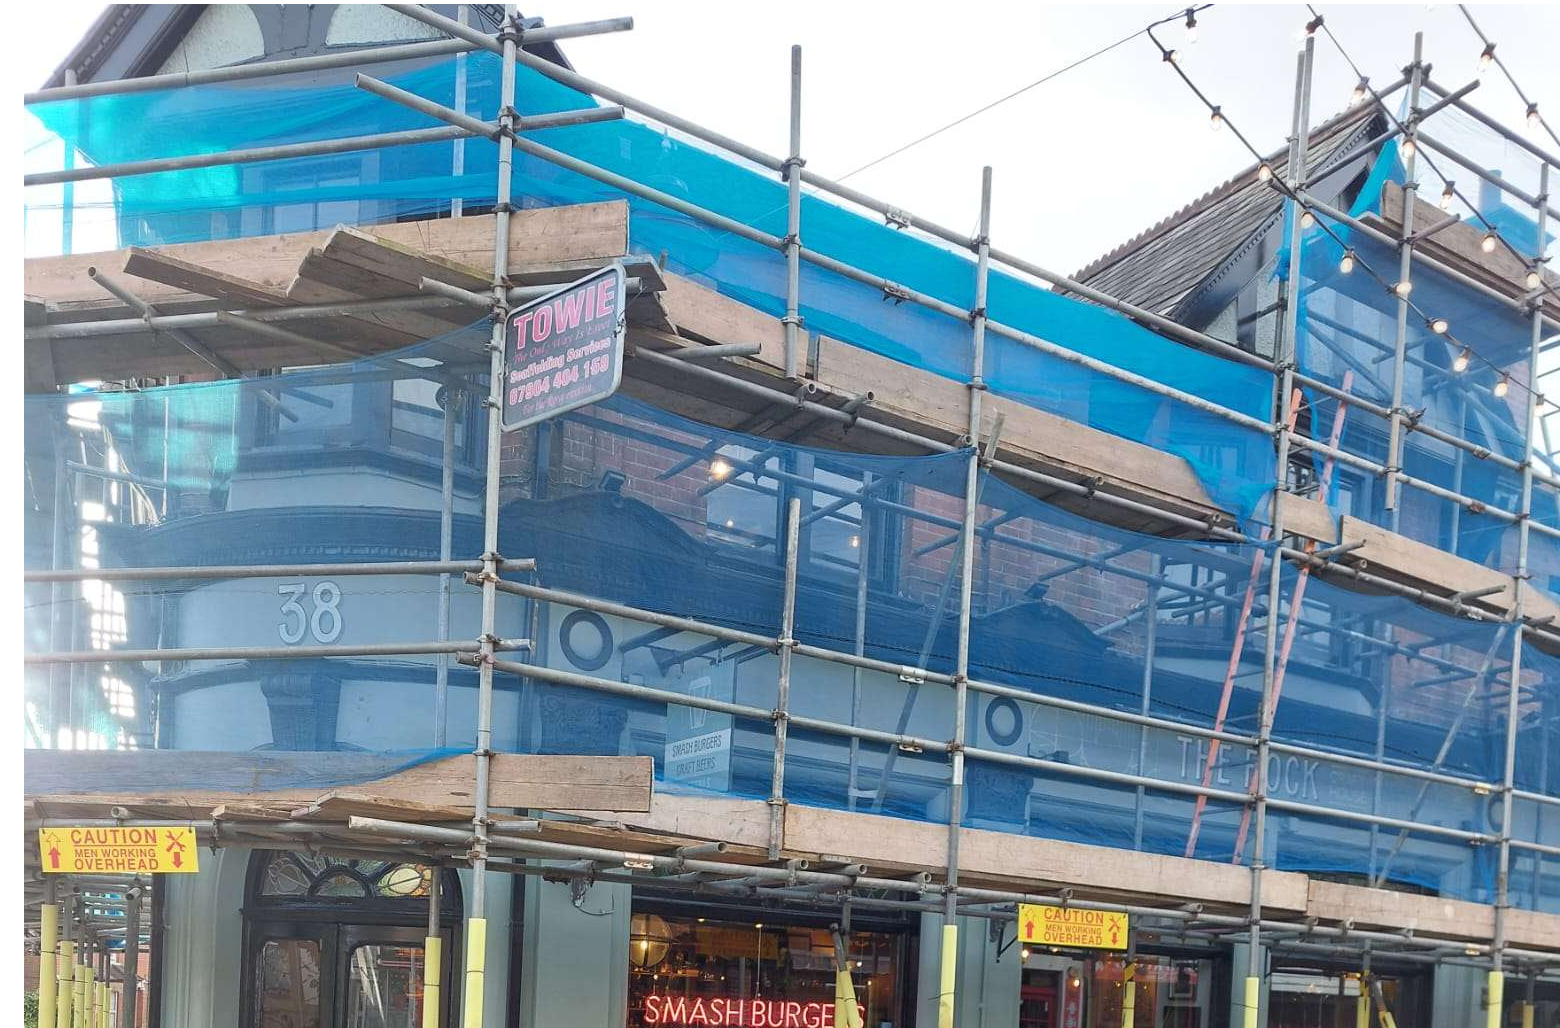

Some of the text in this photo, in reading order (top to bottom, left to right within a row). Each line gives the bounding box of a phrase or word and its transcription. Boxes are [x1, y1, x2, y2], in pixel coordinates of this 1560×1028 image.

[513, 277, 616, 350] TOWIE
[510, 337, 612, 383] Scaffolding Services
[553, 365, 579, 388] 404
[278, 580, 343, 644] 38
[672, 735, 722, 758] SMASH BURGERS
[1177, 736, 1232, 785] THE
[71, 829, 157, 844] CAUTION
[74, 848, 156, 858] MEN WORKING
[74, 858, 159, 871] OVERHEAD
[1044, 908, 1104, 924] CAUTION
[1044, 931, 1103, 945] OVERHEAD
[1045, 923, 1102, 936] MEN WORKING
[644, 996, 744, 1025] SMASH
